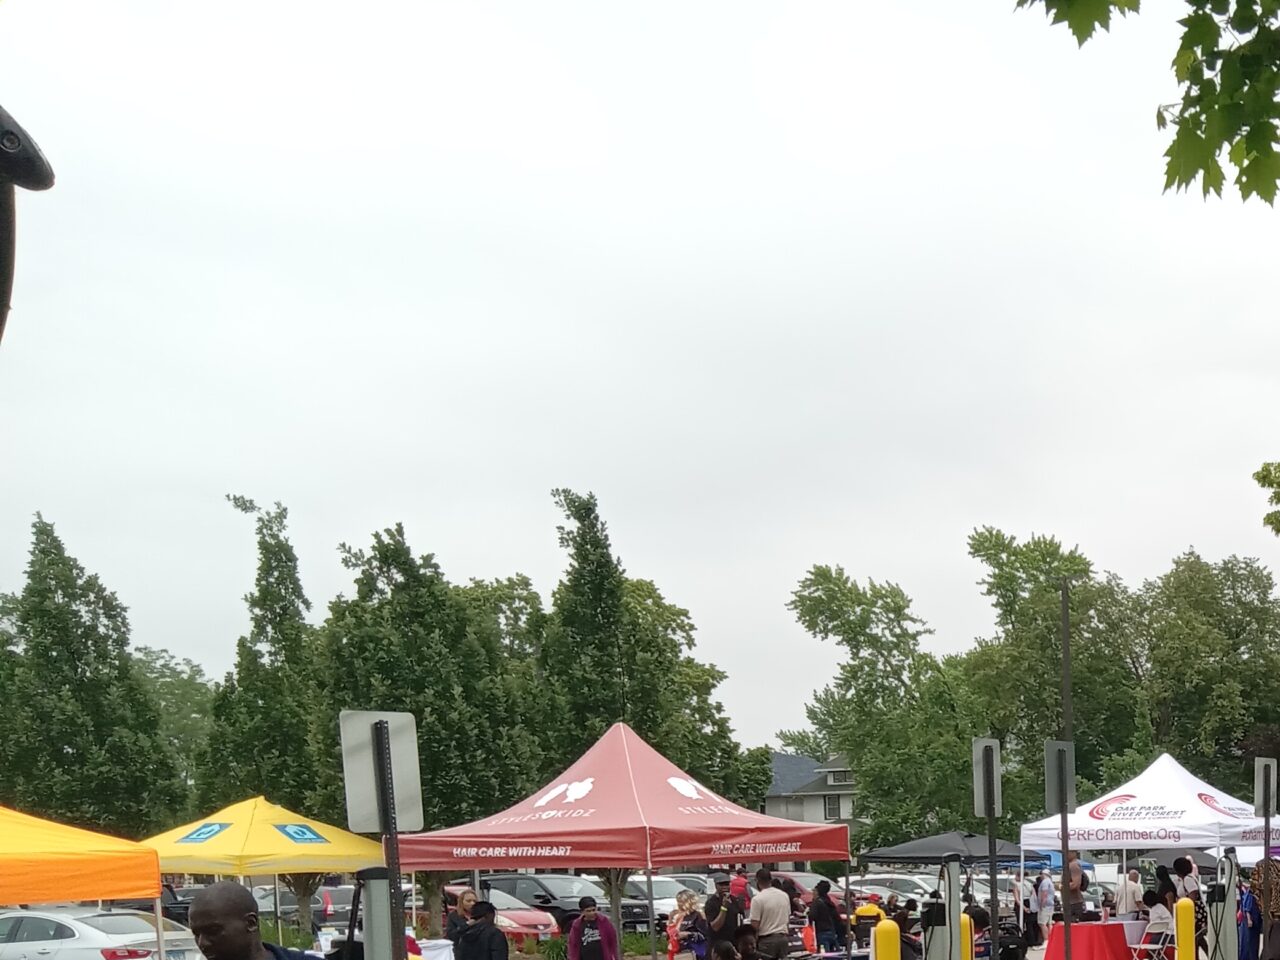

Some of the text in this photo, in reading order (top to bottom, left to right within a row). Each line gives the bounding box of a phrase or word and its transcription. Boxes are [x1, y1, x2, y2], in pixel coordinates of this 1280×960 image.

[452, 846, 572, 857] HAIR CARE WITH HEART
[711, 842, 801, 855] HAIR CARE WITH HEART
